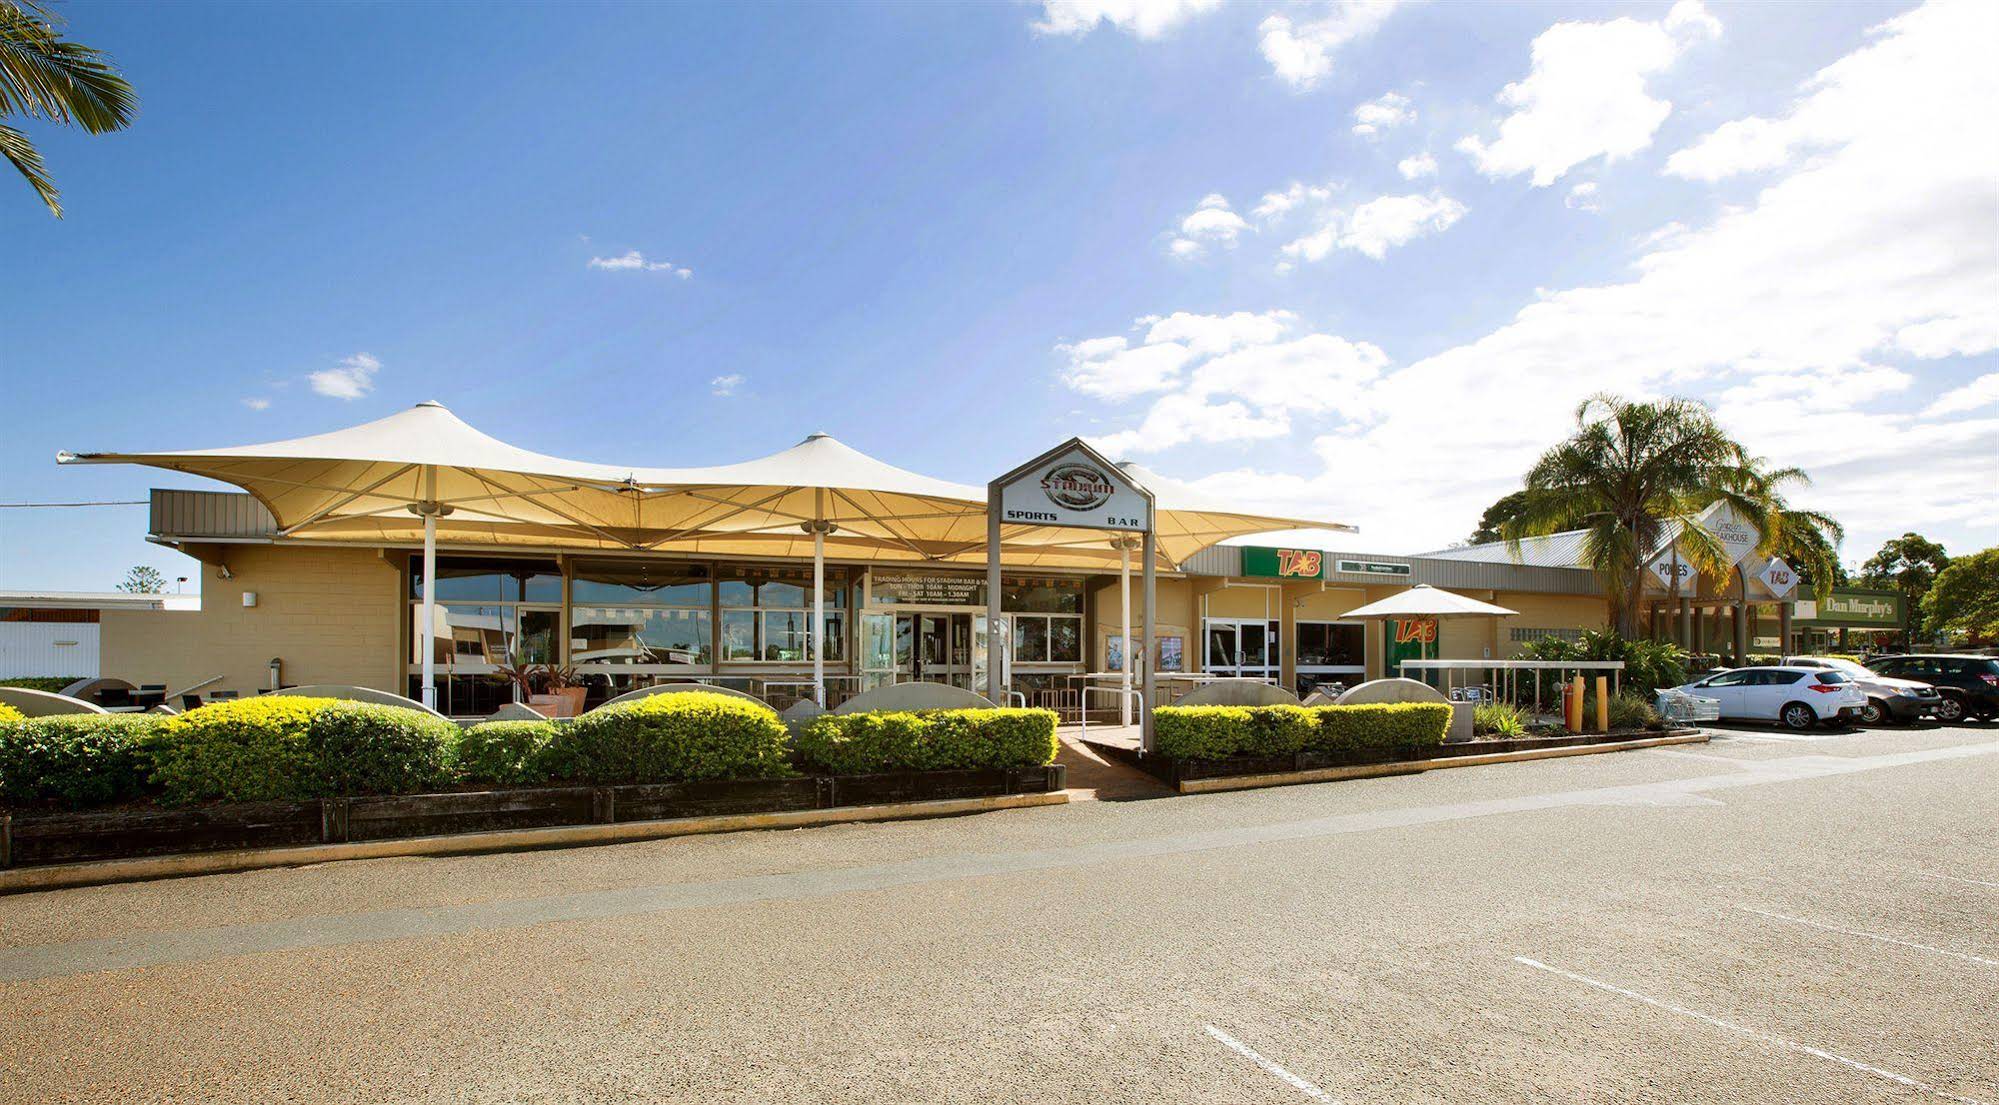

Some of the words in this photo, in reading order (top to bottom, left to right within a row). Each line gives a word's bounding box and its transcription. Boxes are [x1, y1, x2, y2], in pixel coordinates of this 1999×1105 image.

[1007, 510, 1057, 521] SPORTS
[1108, 517, 1138, 526] BAR
[1276, 549, 1322, 577] TAB
[1769, 570, 1789, 584] TAB
[1826, 597, 1848, 612] Dan
[1848, 598, 1892, 618] Murphy's
[1394, 619, 1439, 644] TAB
